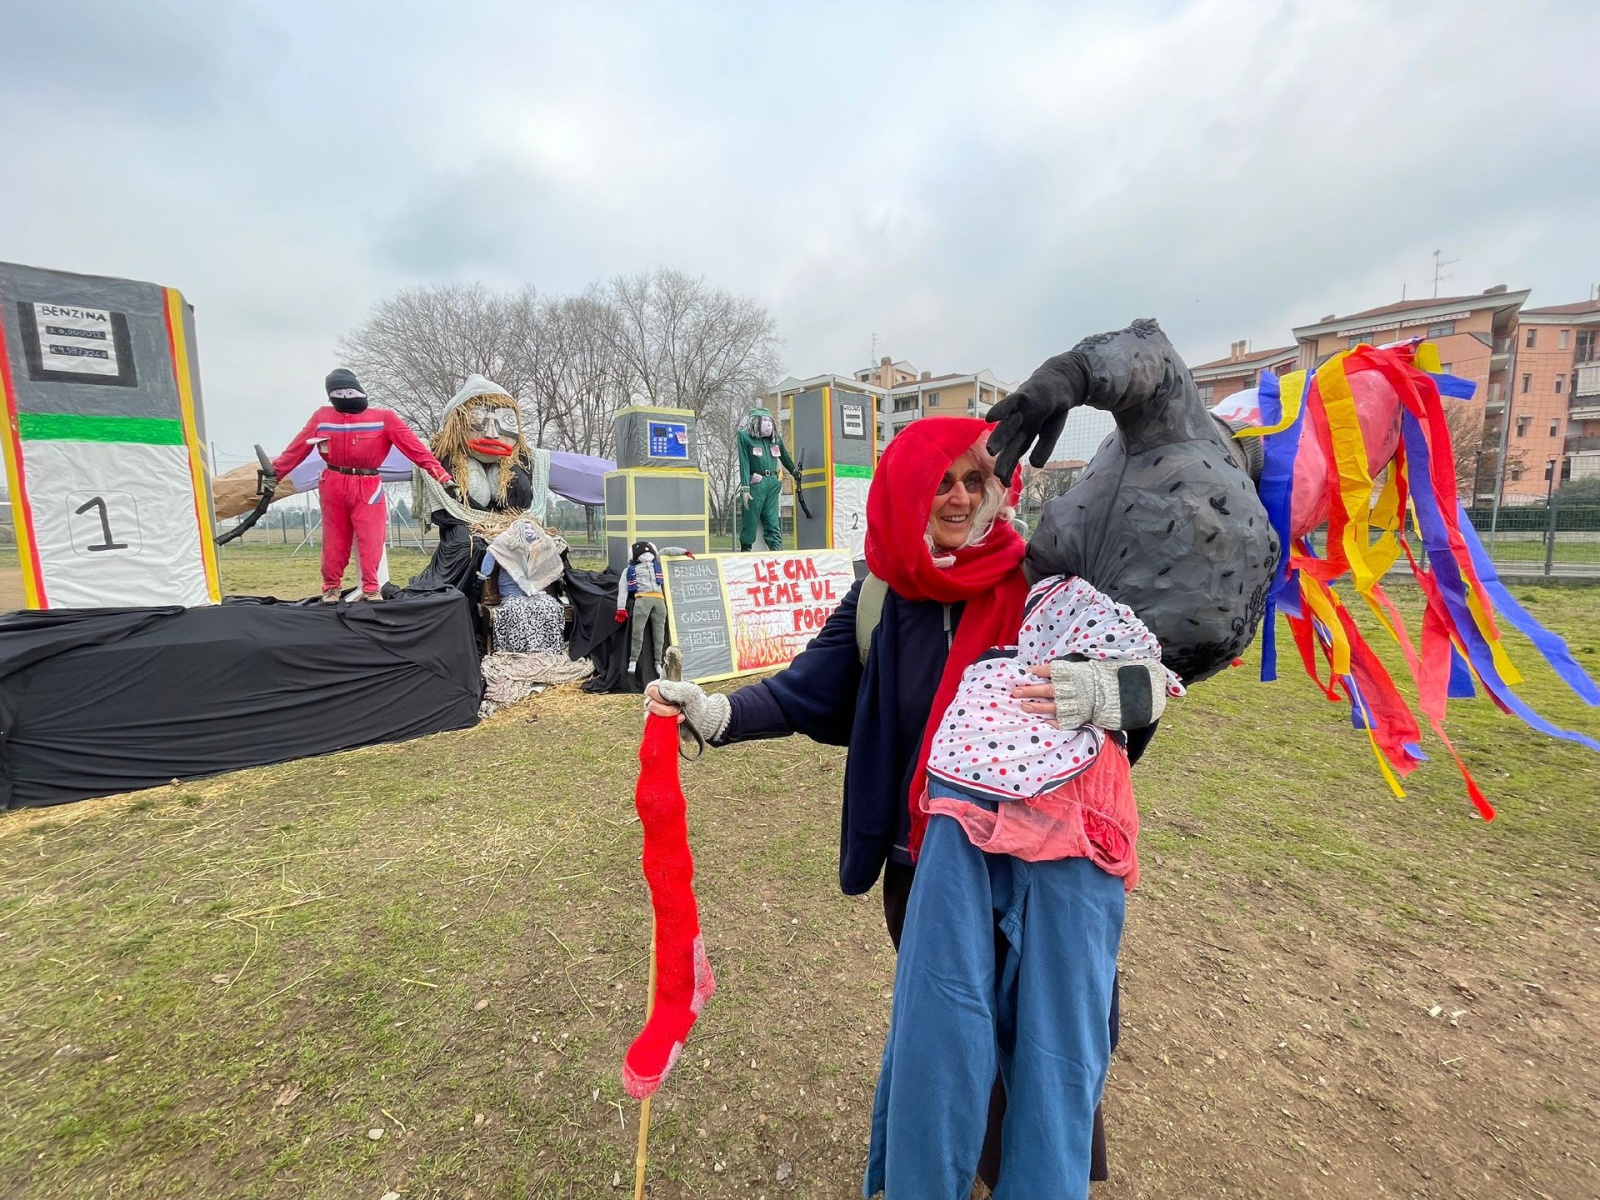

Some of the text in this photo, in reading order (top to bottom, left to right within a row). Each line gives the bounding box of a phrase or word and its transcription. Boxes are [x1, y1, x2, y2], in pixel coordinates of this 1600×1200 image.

[42, 306, 107, 322] BENZINA
[75, 496, 128, 552] 1
[851, 512, 859, 530] 2
[674, 564, 718, 578] BENZINA
[811, 579, 836, 601] UL
[681, 609, 721, 624] GASOLIO
